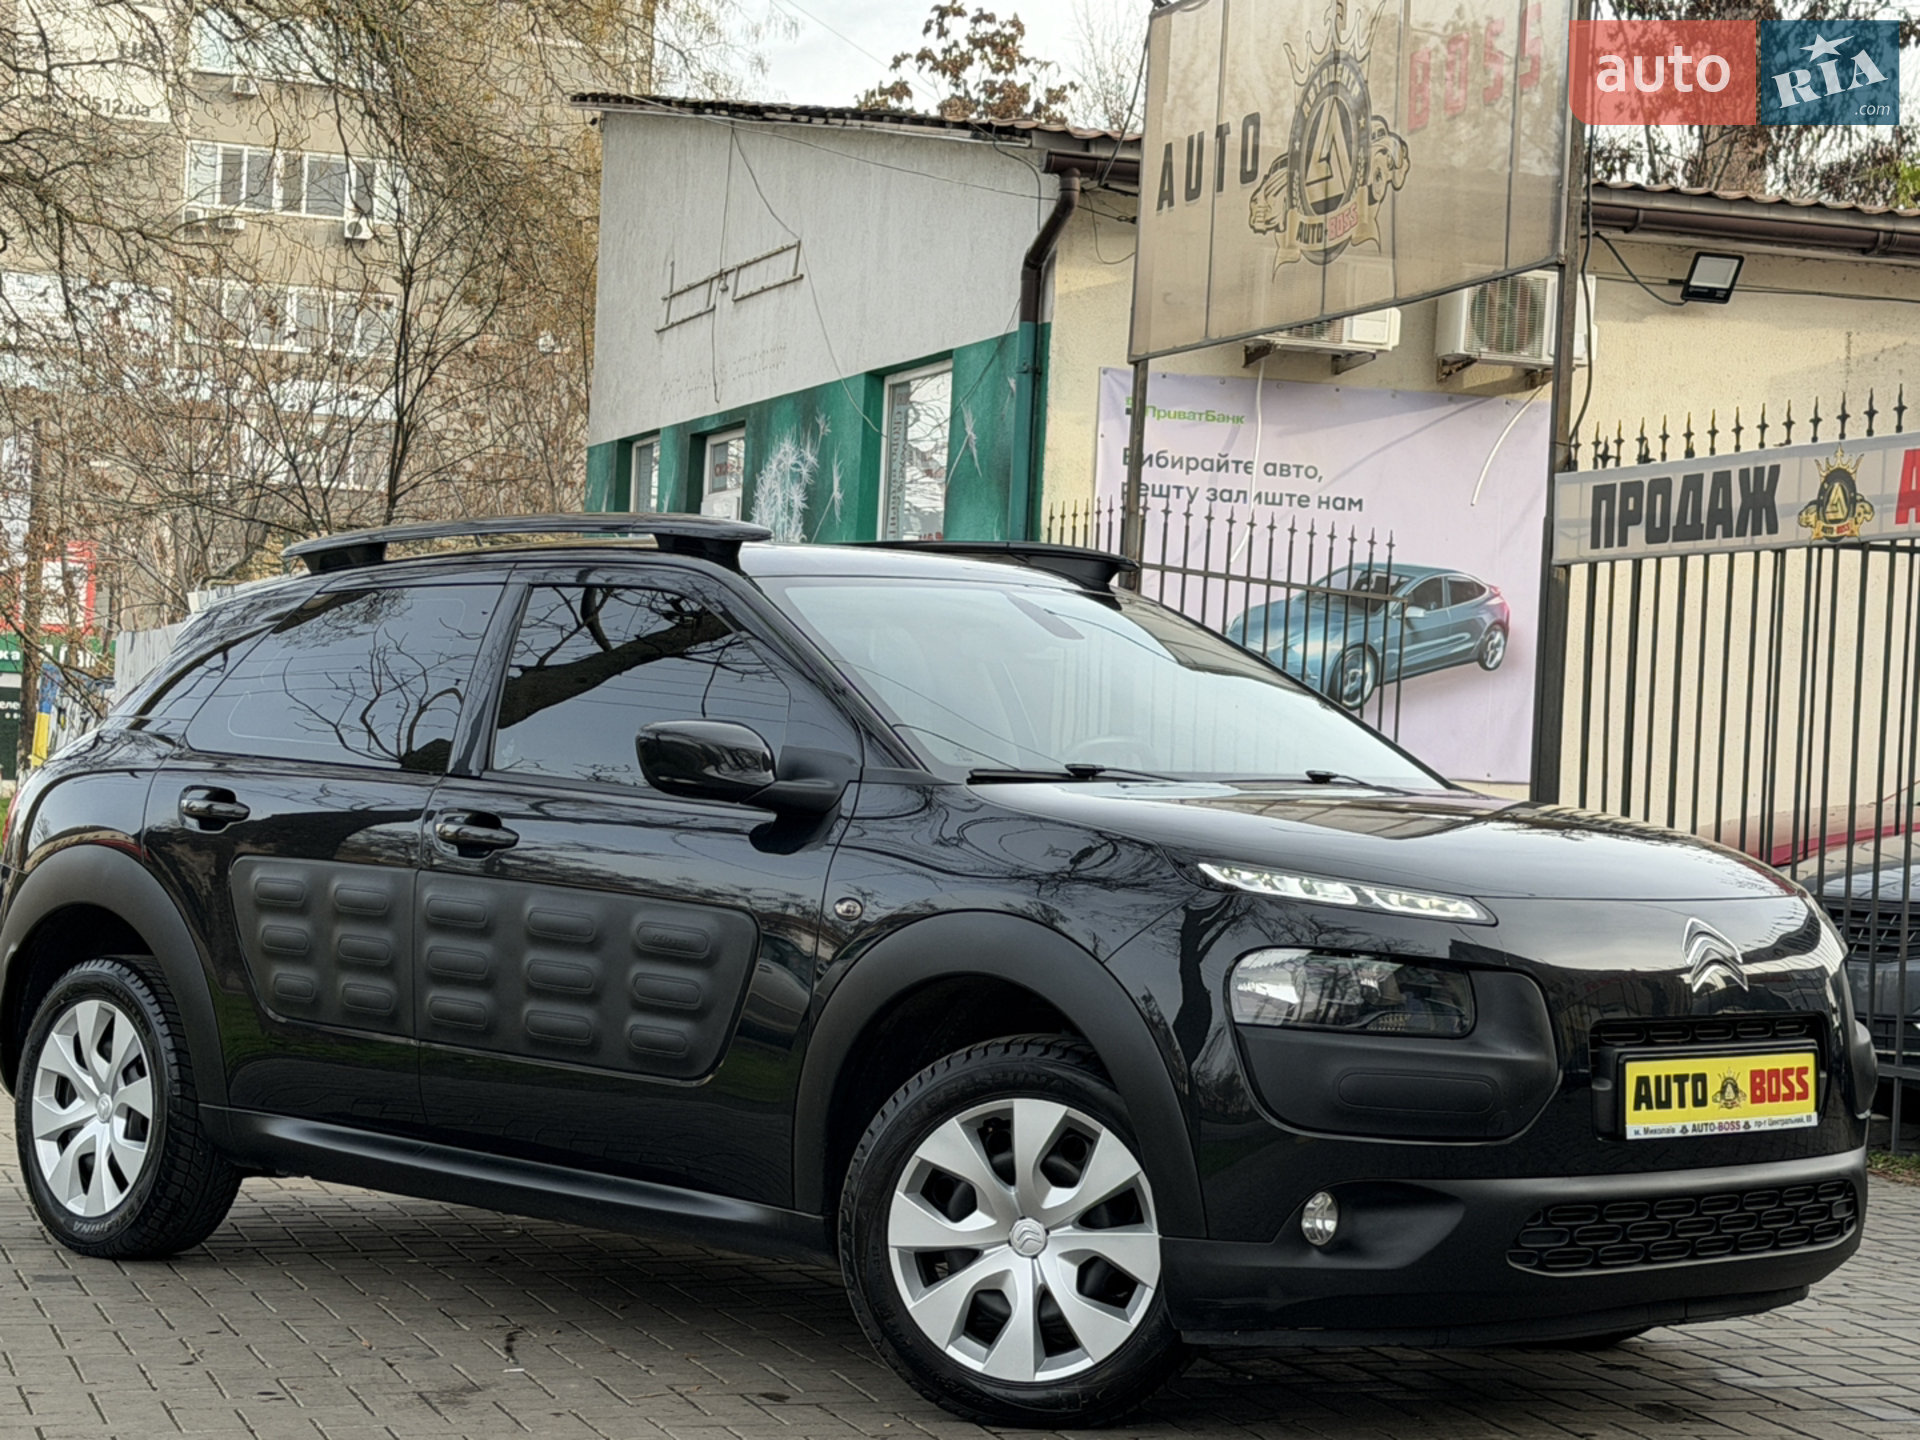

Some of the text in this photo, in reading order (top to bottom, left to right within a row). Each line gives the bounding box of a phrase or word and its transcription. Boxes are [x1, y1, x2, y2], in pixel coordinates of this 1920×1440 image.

[1156, 3, 1542, 213] AUTO BOSS
[1263, 461, 1323, 483] авто,
[1206, 486, 1311, 509] залиште
[1317, 493, 1364, 512] нам
[1590, 464, 1781, 550] ПРОДАЖ
[1633, 1066, 1809, 1111] AUTO BOSS
[1691, 1121, 1741, 1133] AUTO-BOSS
